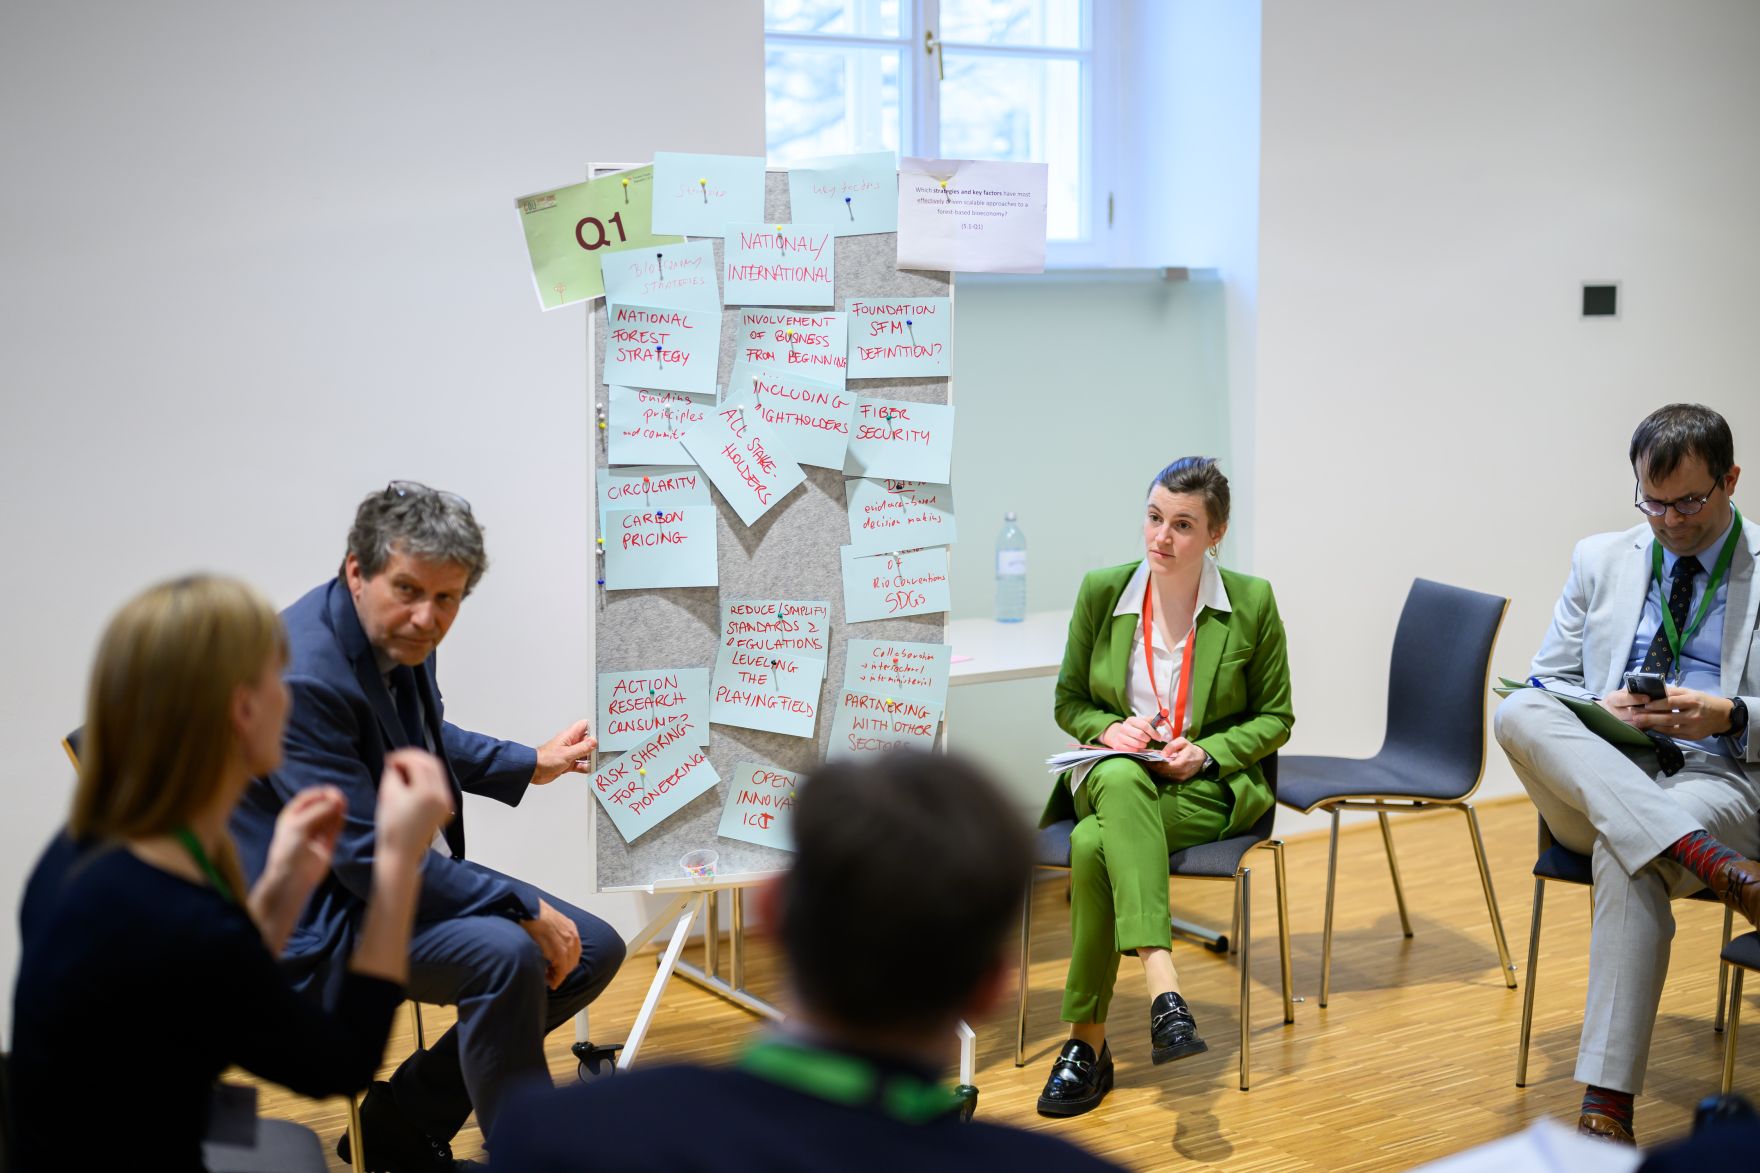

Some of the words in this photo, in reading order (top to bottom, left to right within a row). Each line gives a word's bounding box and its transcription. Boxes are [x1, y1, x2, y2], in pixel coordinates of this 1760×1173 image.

[972, 189, 983, 197] key
[575, 212, 627, 251] Q1
[728, 263, 832, 283] INTERNATIONAL
[617, 308, 694, 329] NATIONAL
[852, 302, 936, 318] FOUNDATION
[743, 314, 837, 327] INVOLVEMENT
[870, 320, 903, 337] SFM
[611, 328, 671, 345] FOREST
[750, 331, 766, 340] OF
[616, 347, 691, 367] STRATEGY
[746, 348, 776, 363] FROM
[753, 380, 849, 409] INCLUDING
[860, 404, 911, 420] FIBER
[719, 409, 748, 439] ALL
[856, 424, 930, 447] SECURITY
[721, 443, 772, 506] HOLDERS
[607, 475, 696, 500] CIRCULARITY
[622, 510, 684, 529] CARBON
[622, 530, 688, 551] PRICING
[726, 619, 800, 635] STANDARDS
[612, 674, 678, 697] ACTION
[738, 671, 768, 685] THE
[608, 692, 687, 715] RESEARCH
[852, 716, 888, 731] WITH
[595, 762, 629, 793] RISK
[631, 724, 695, 771] SHARING
[628, 753, 705, 816] PIONEERING
[752, 769, 797, 788] OPEN
[608, 781, 645, 805] FOR
